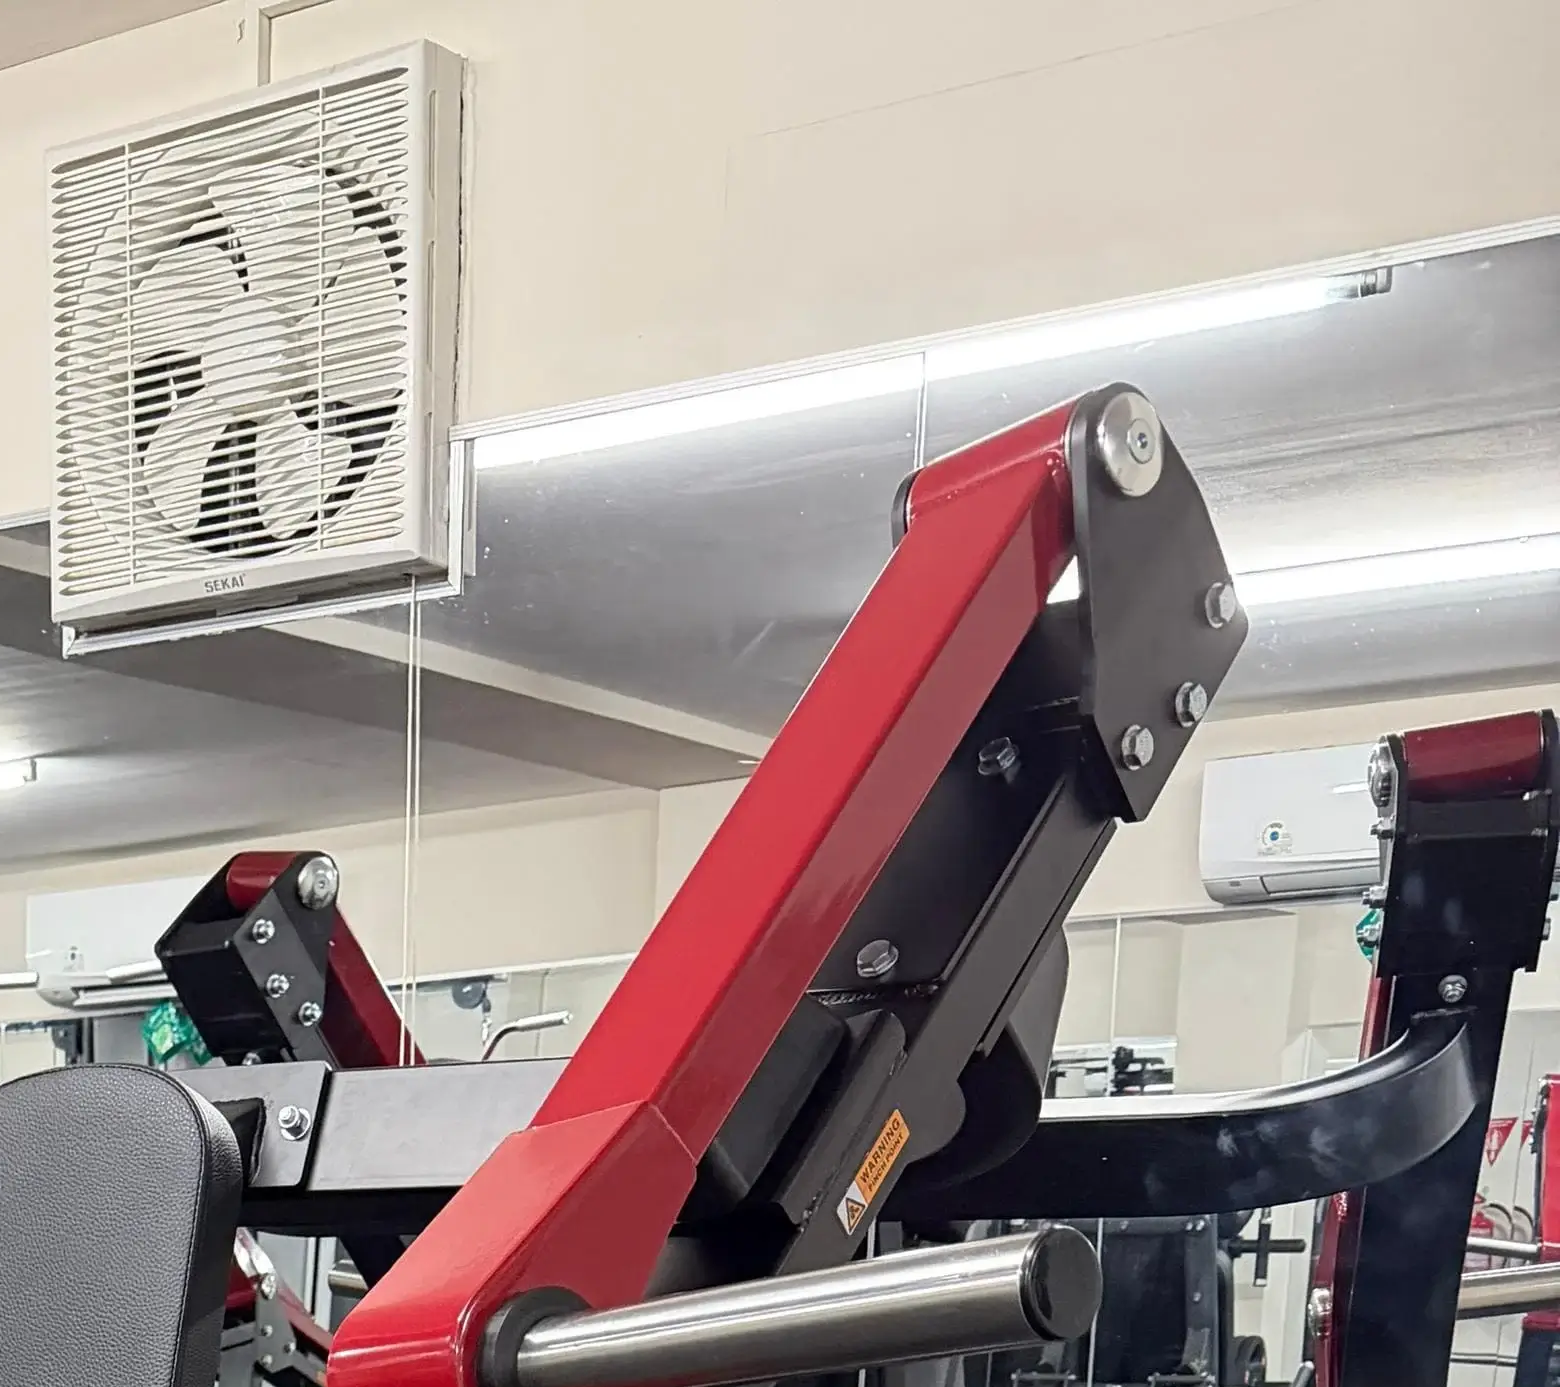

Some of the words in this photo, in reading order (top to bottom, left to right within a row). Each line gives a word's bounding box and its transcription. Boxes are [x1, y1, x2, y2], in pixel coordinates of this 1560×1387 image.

[204, 574, 245, 593] SEKAI
[860, 1117, 900, 1183] WARNING
[867, 1162, 887, 1192] PINCH
[884, 1133, 904, 1162] POINT
